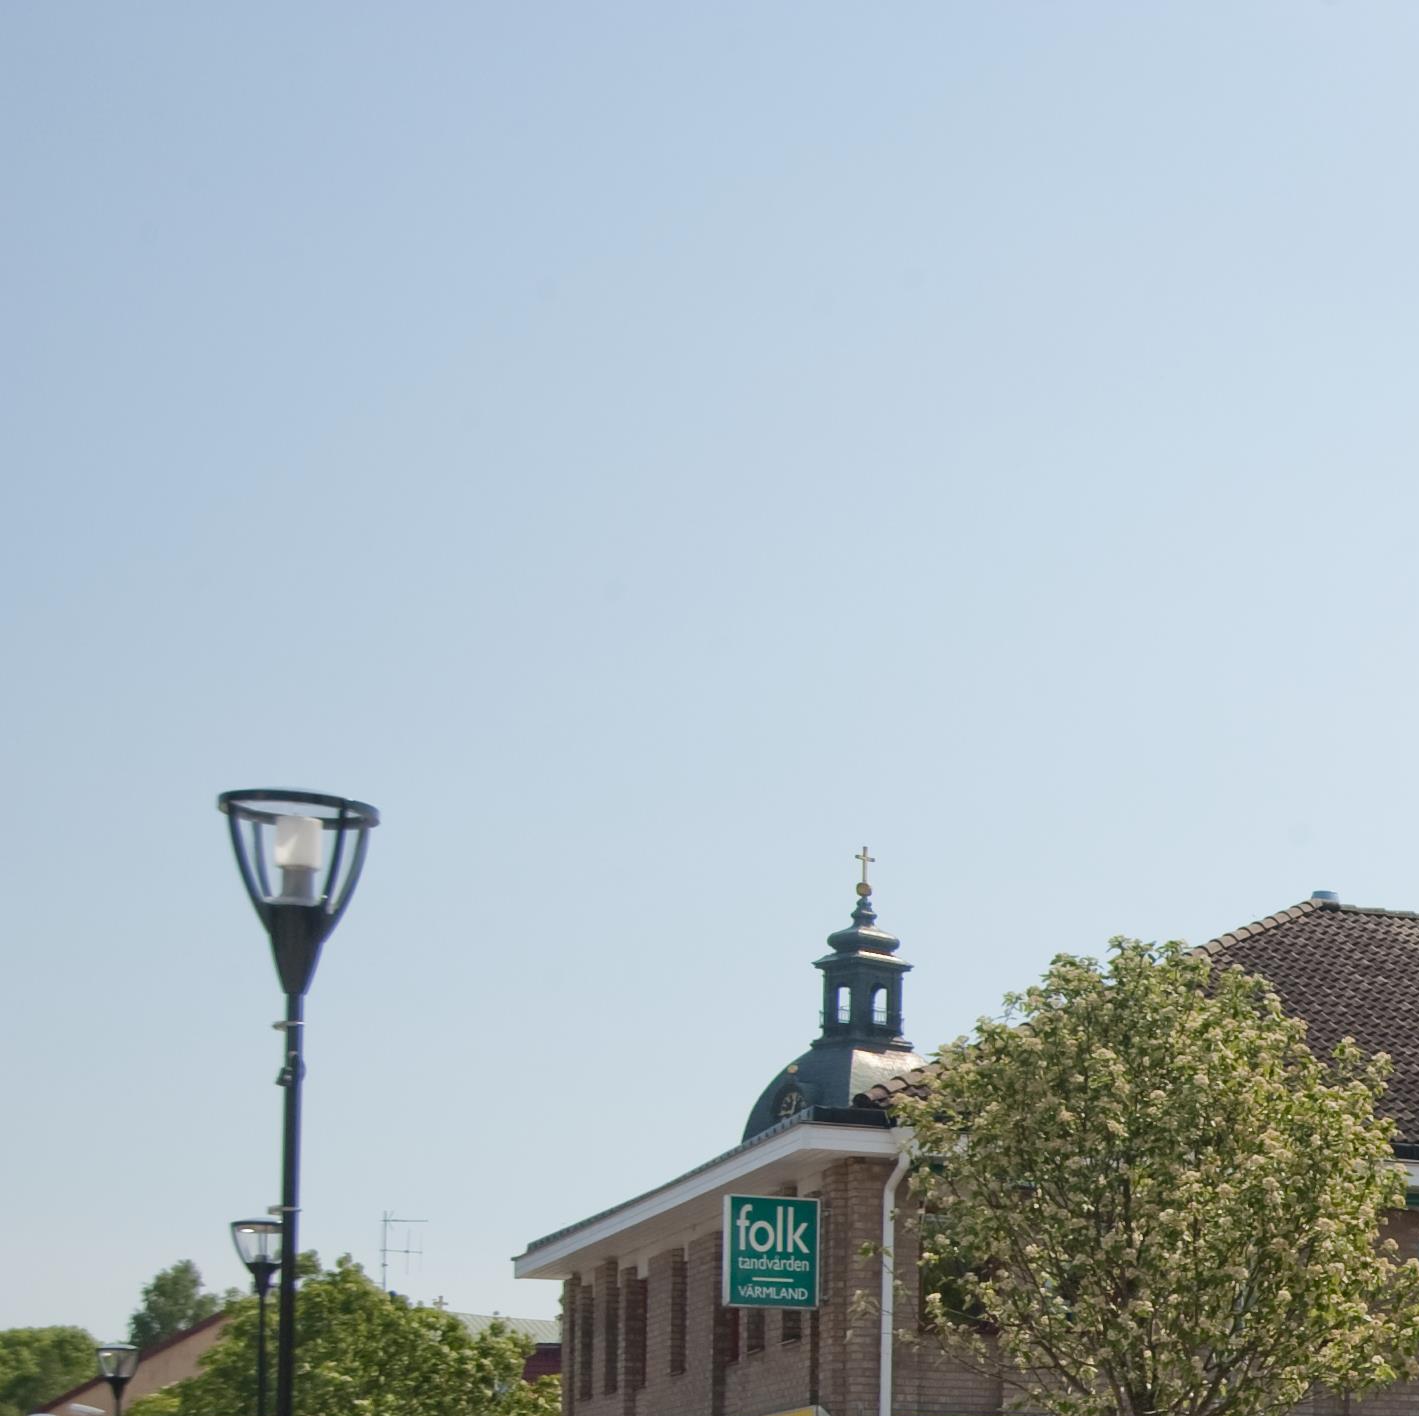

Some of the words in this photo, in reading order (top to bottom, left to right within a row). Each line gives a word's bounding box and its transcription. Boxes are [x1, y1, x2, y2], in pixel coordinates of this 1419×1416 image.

[736, 1203, 810, 1253] folk
[738, 1254, 810, 1272] tandvården
[738, 1283, 809, 1300] VÄRMLAND
